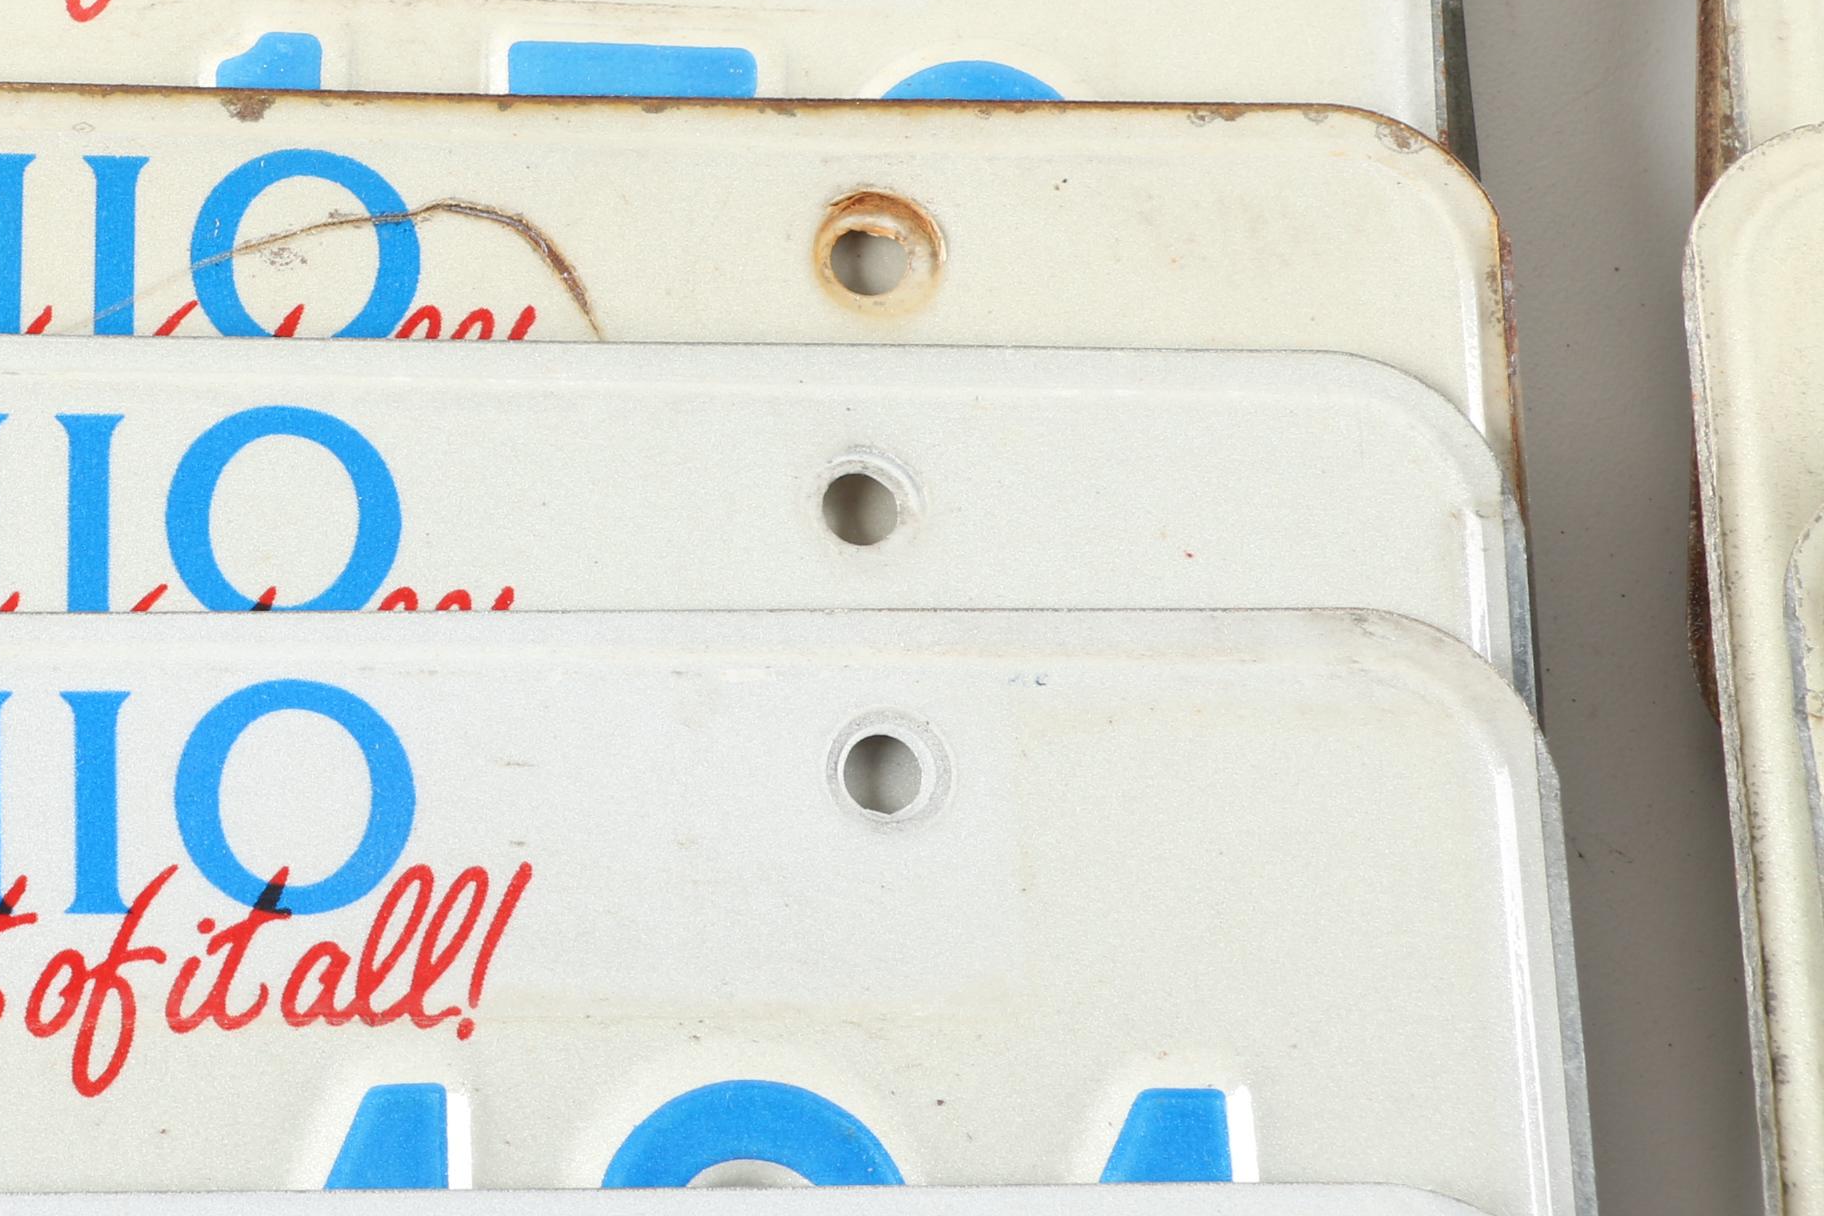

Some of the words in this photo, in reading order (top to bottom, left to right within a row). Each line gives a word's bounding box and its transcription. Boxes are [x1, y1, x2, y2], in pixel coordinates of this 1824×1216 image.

[24, 863, 179, 1098] of
[165, 865, 292, 1035] it
[281, 862, 533, 1041] all!
